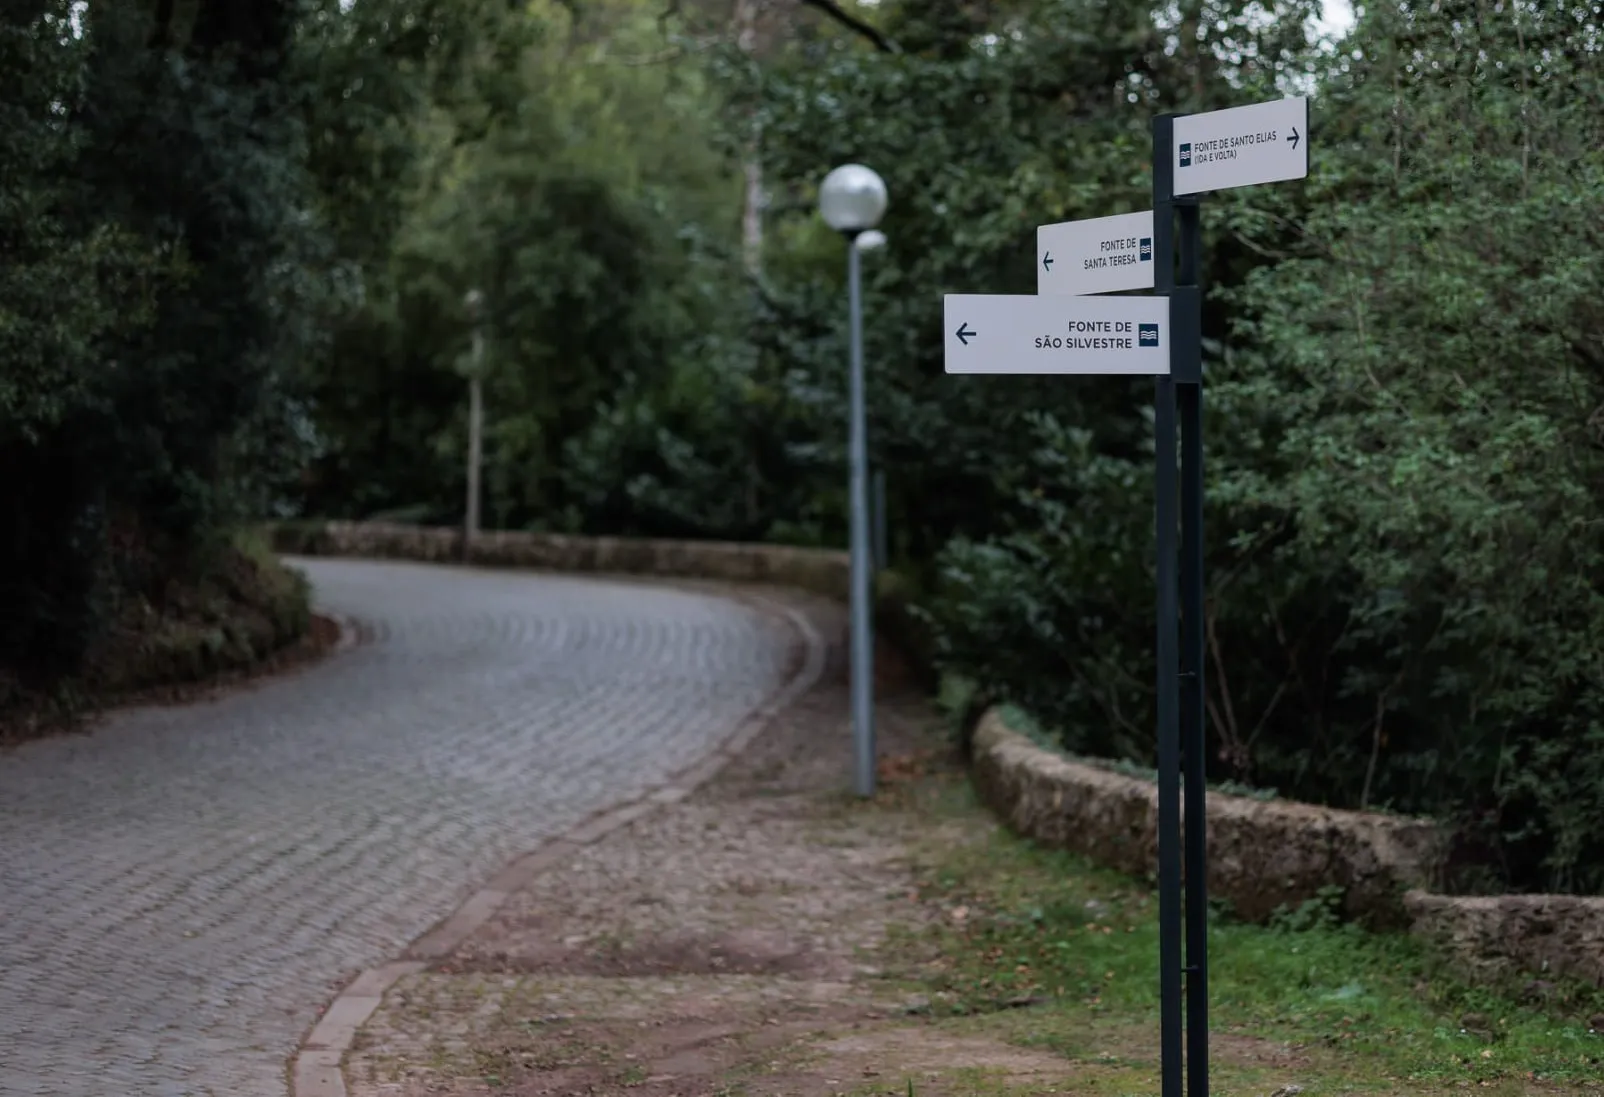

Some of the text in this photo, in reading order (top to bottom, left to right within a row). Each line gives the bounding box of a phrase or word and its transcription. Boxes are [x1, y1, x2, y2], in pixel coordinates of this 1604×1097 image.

[1194, 130, 1277, 153] FONTE DE SANTO ELIAS
[1194, 149, 1237, 164] (IDA E VOLTA)
[1100, 237, 1136, 252] FONTE DE
[1084, 254, 1137, 270] SANTA TERESA
[1068, 321, 1132, 332] FONTE DE
[1034, 335, 1132, 349] SÃO SILVESTRE
